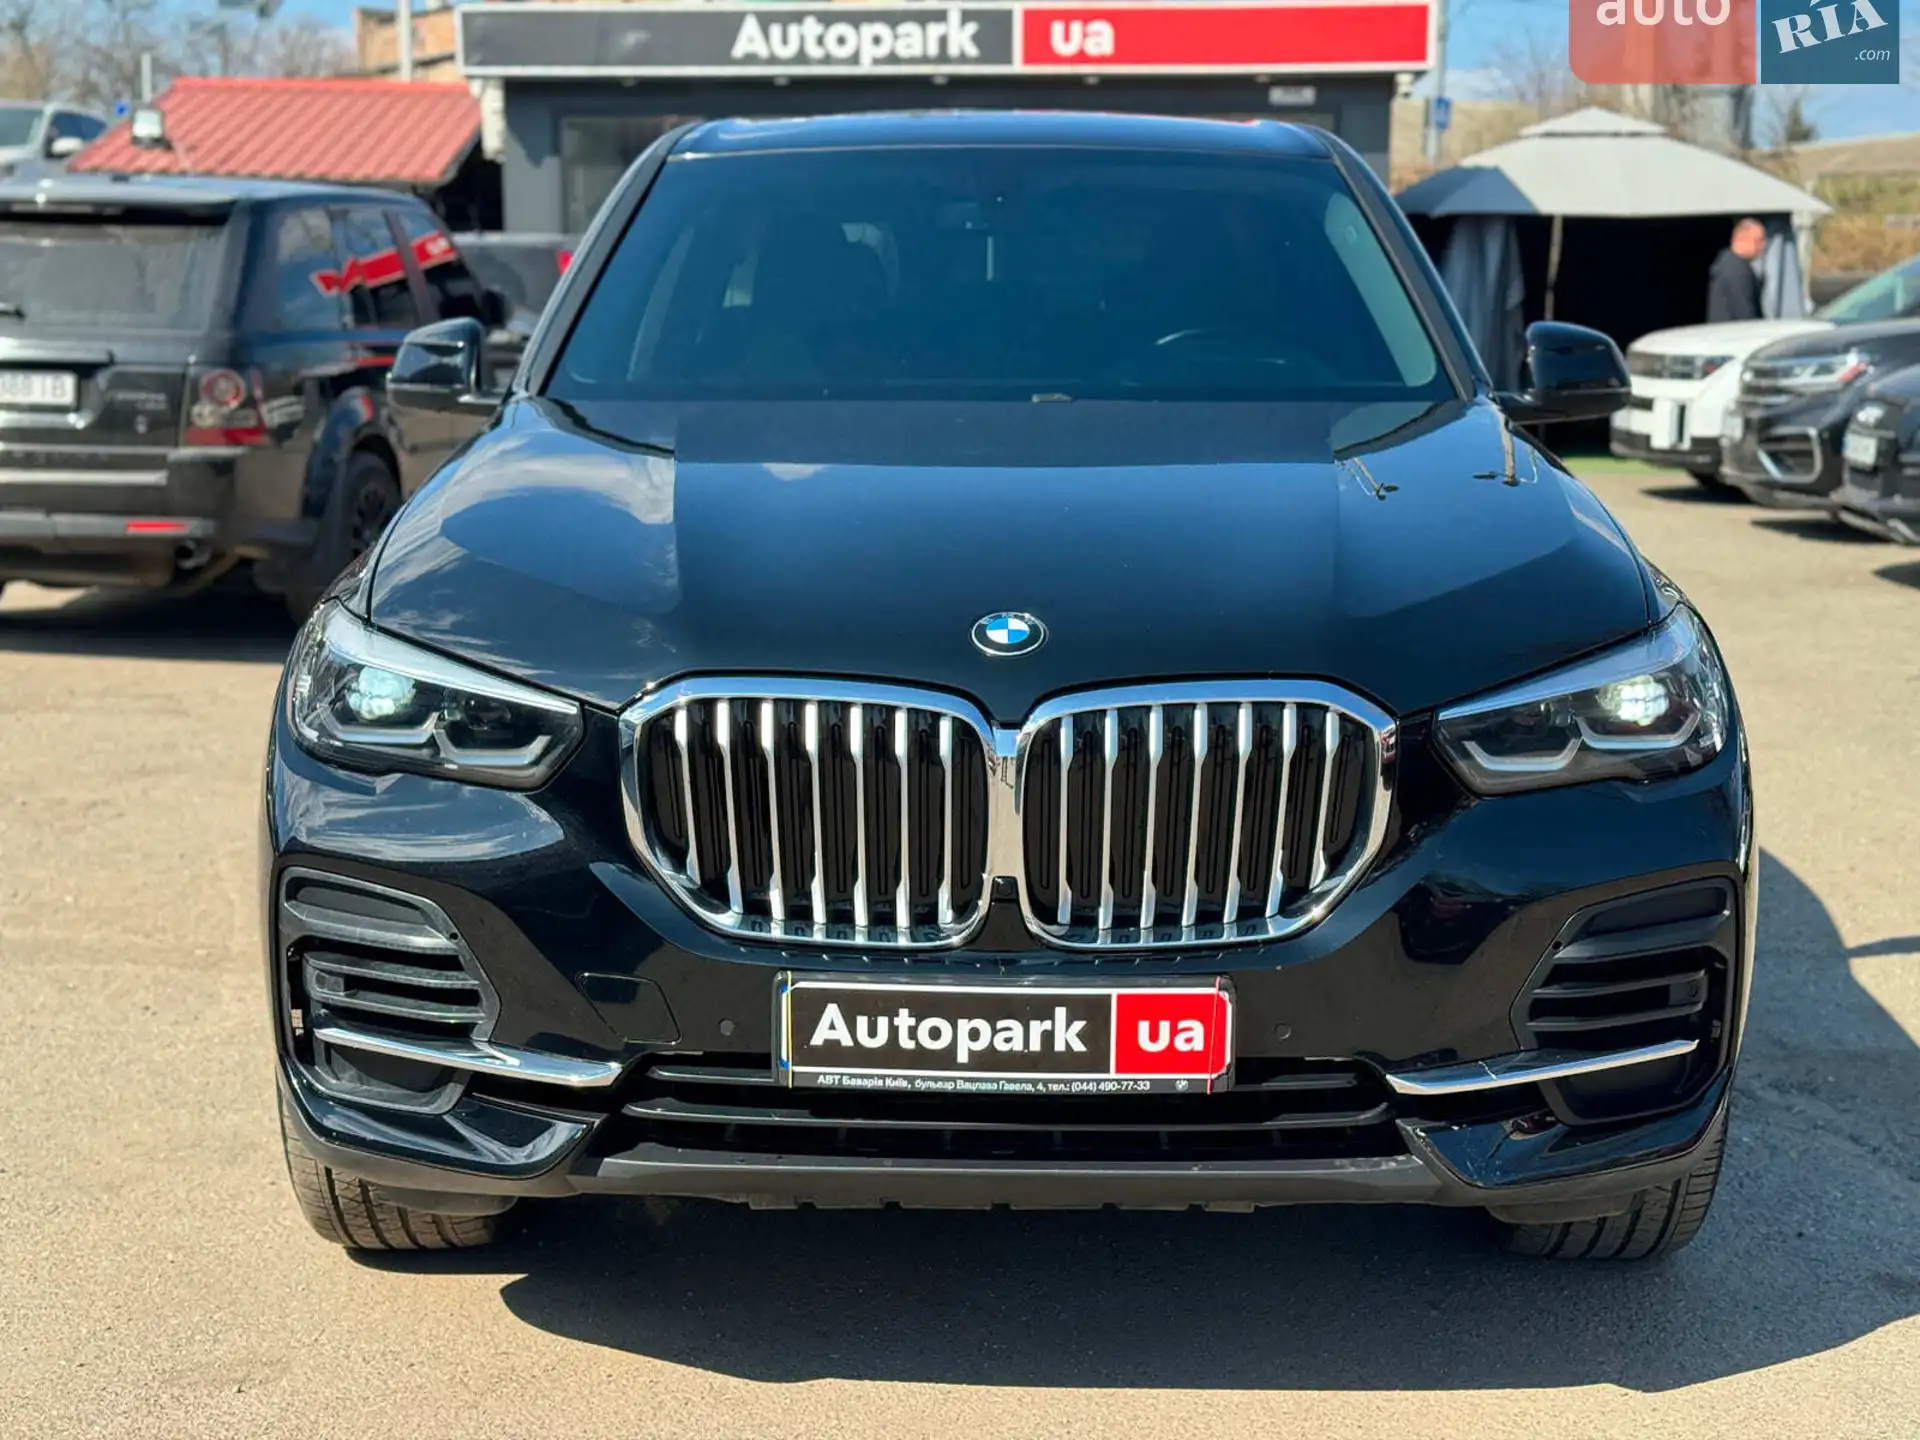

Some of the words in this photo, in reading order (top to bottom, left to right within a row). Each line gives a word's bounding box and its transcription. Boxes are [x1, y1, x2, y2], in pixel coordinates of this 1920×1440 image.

[731, 9, 980, 66] Autopark
[1050, 19, 1115, 56] ua
[810, 1002, 1088, 1063] Autopark
[1137, 1019, 1205, 1052] ua
[817, 1074, 841, 1085] АВТ
[1071, 1080, 1097, 1093] (044)
[1098, 1080, 1151, 1091] 490-77-33
